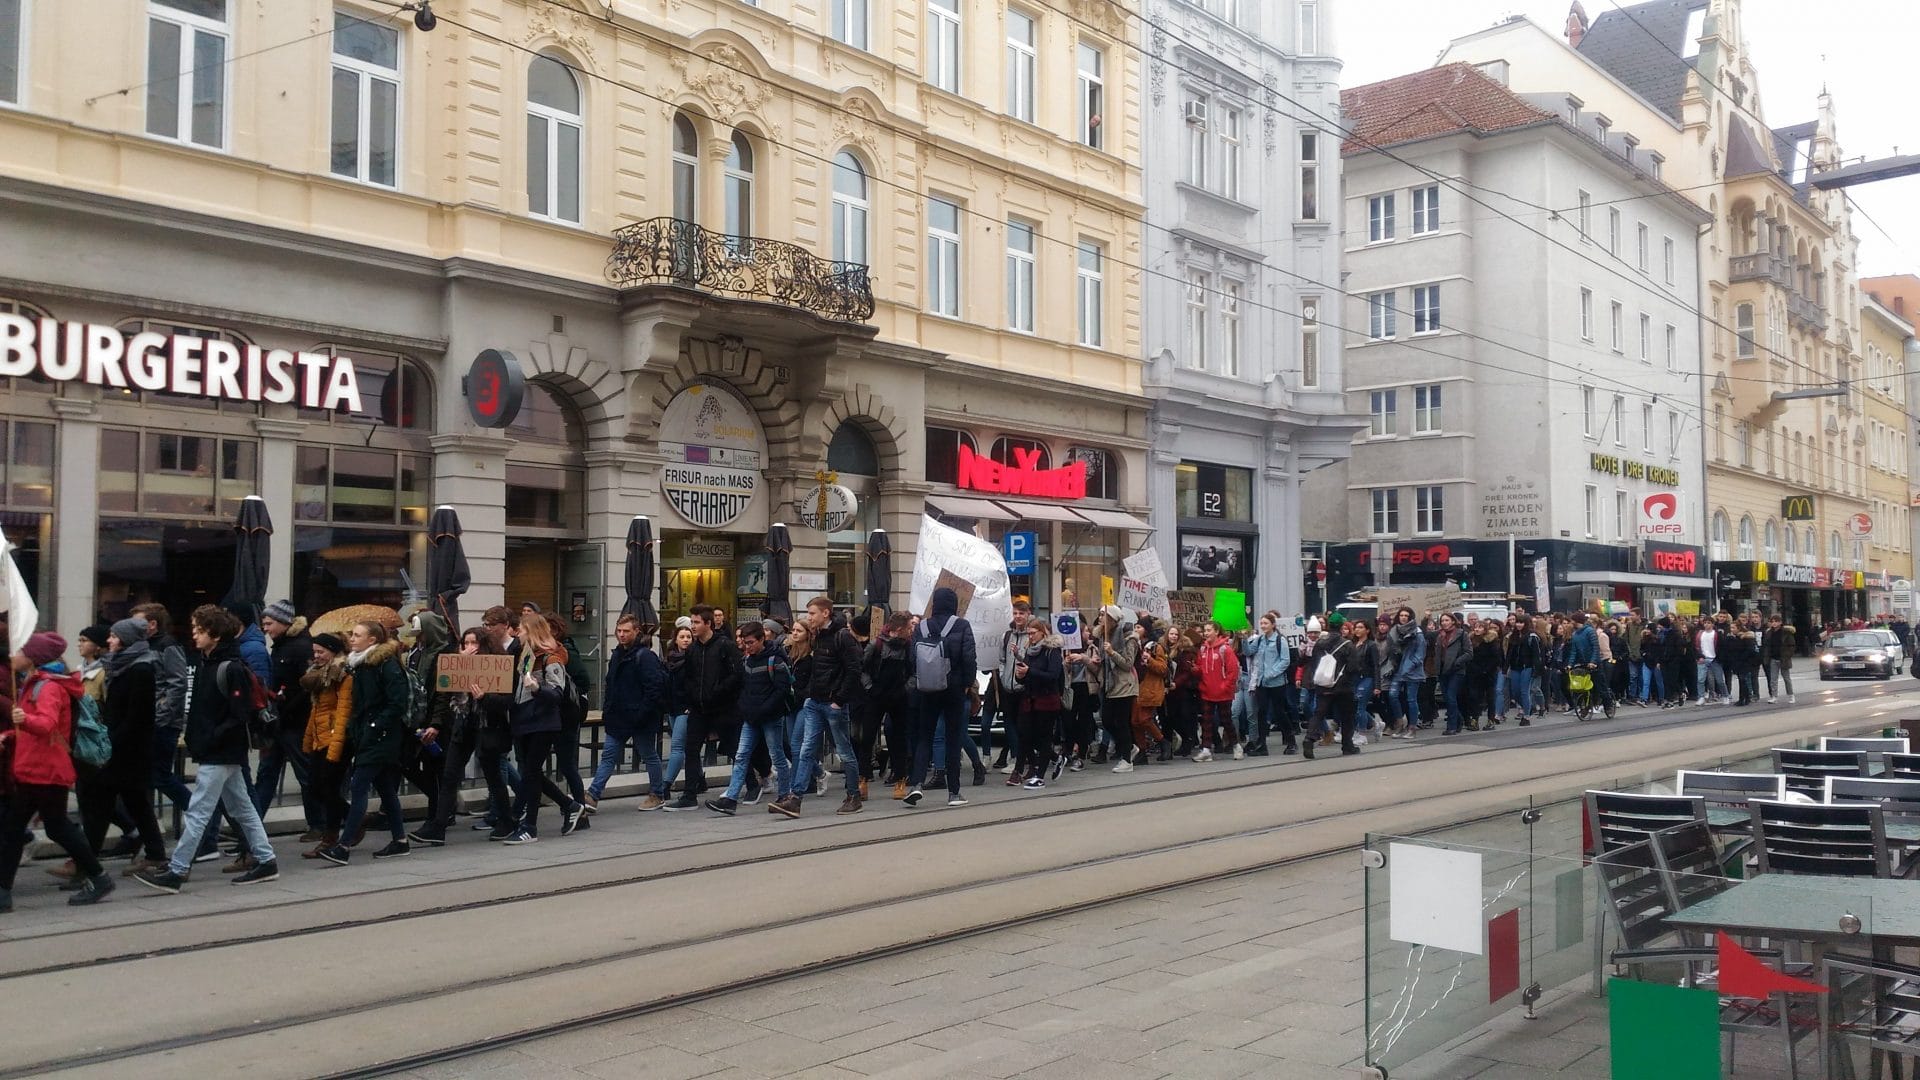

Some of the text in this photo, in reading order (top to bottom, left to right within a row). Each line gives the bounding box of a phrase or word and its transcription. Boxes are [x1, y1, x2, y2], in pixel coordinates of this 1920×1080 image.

[0, 313, 362, 412] BURGERISTA
[665, 468, 754, 489] FRISUR nach MASS
[1592, 453, 1681, 487] HOTEL DREI KRONEN
[666, 488, 752, 525] GERHARDT
[1203, 492, 1221, 513] E2
[1485, 493, 1539, 502] DREI KRONEN
[1482, 503, 1544, 515] FREMDEN
[1486, 517, 1539, 529] ZIMMER
[1639, 523, 1682, 534] ruefa
[1010, 535, 1026, 561] P
[1359, 548, 1425, 566] rfa
[1122, 578, 1149, 594] TIME
[1150, 585, 1159, 598] IS
[480, 656, 489, 671] IS
[494, 656, 512, 671] NO
[451, 673, 501, 692] POLICY!
